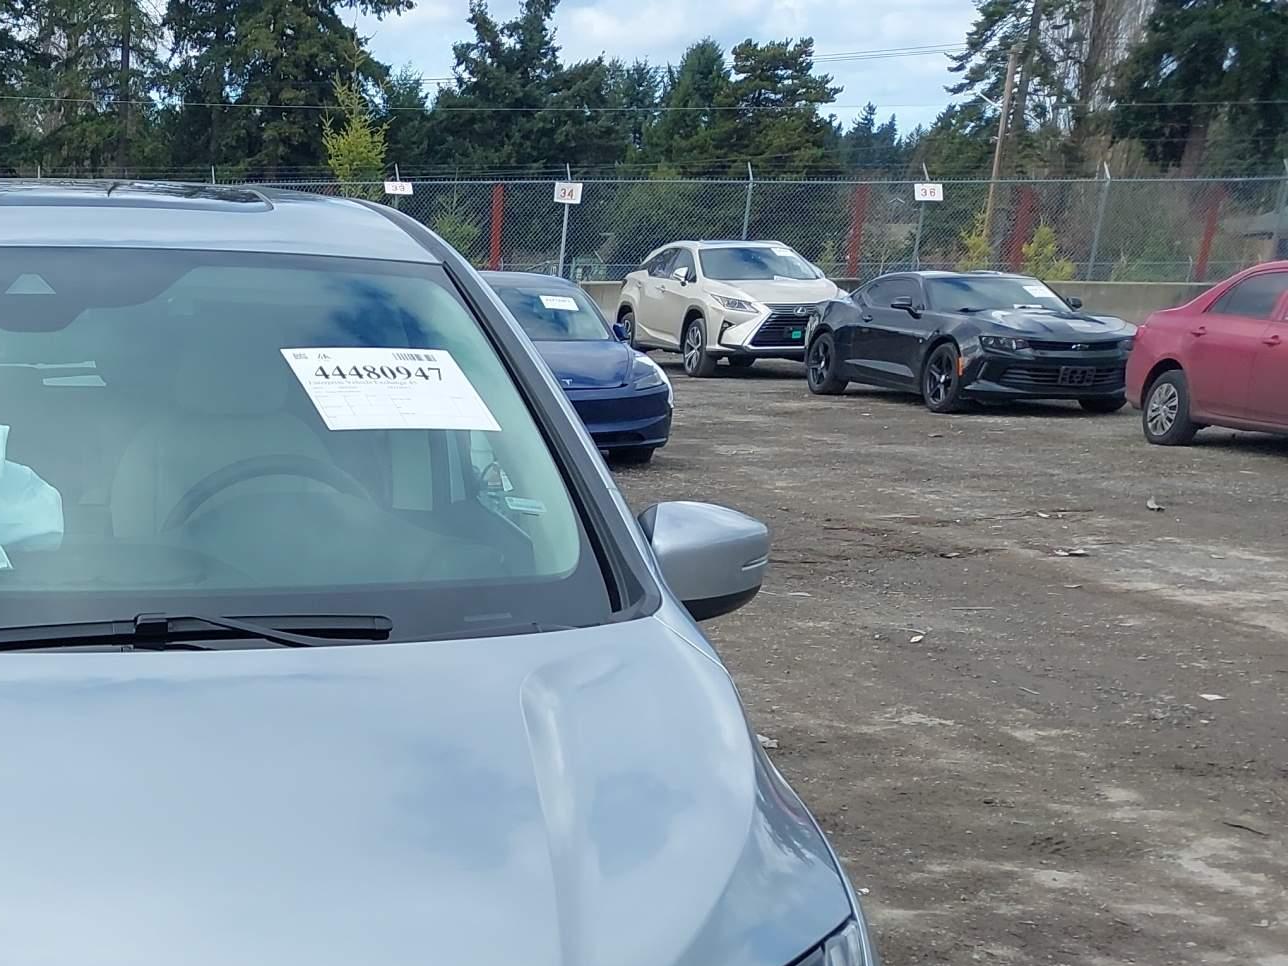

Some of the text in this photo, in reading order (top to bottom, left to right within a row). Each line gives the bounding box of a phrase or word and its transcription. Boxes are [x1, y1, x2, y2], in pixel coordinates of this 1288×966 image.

[560, 188, 574, 199] 34
[920, 188, 936, 197] 36
[314, 365, 442, 381] 44480947
